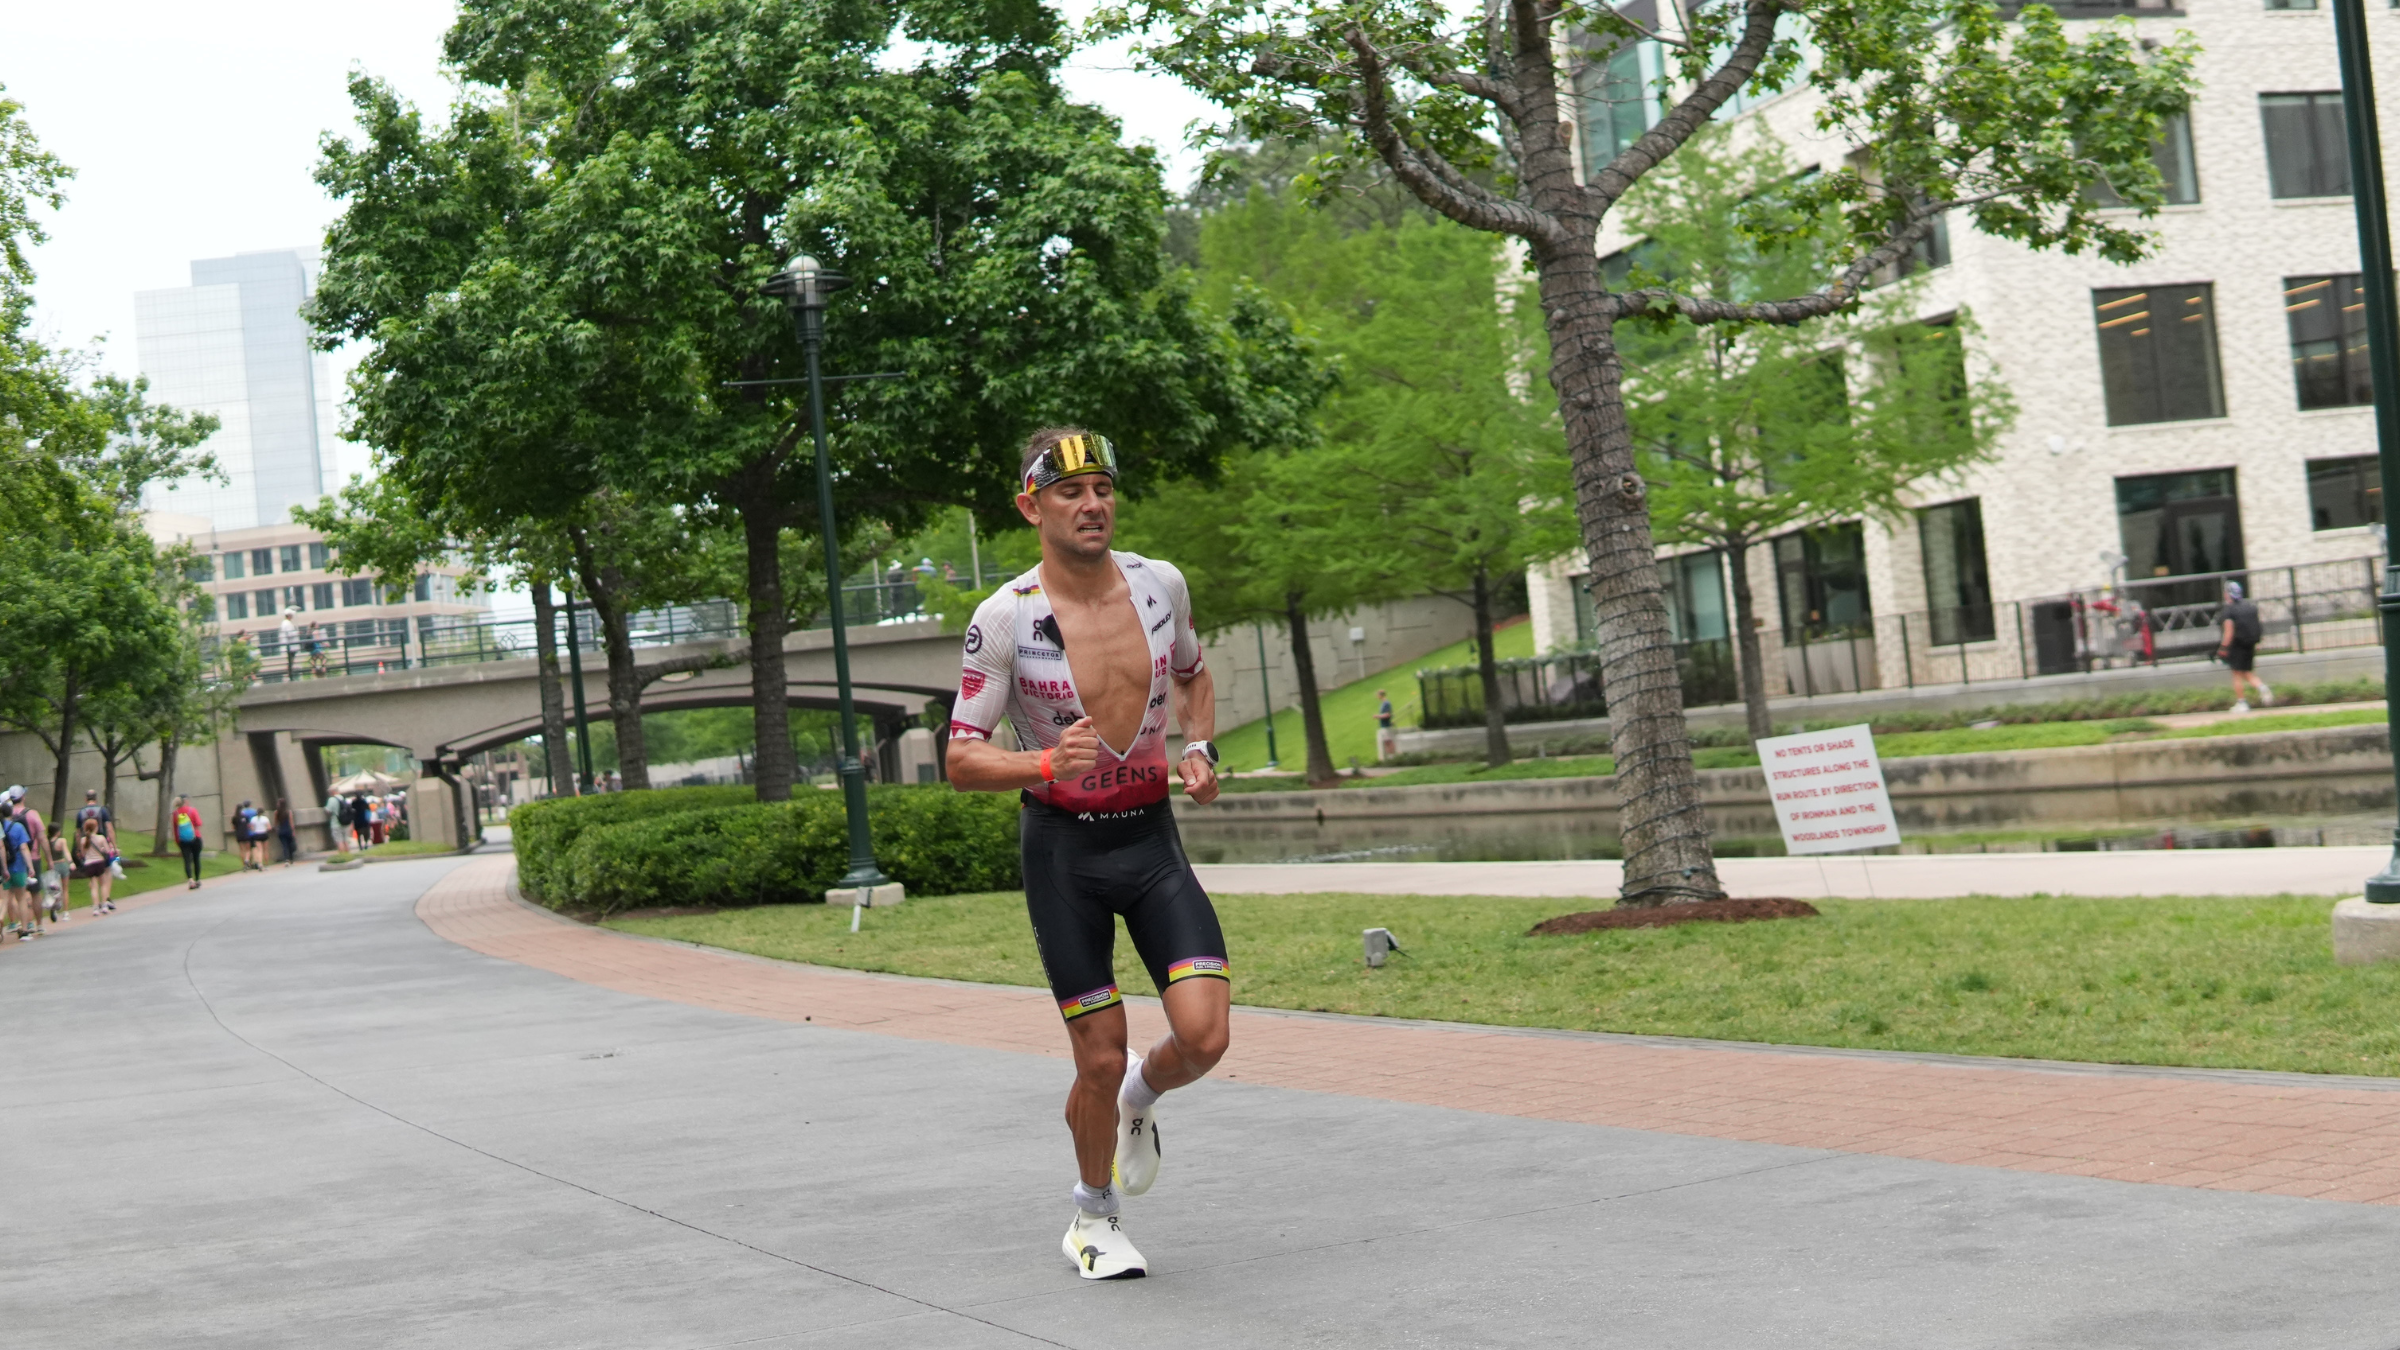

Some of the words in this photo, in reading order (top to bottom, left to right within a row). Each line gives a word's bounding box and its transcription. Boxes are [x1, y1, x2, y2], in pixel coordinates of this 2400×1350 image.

[1151, 611, 1172, 635] RIDLEY
[1019, 677, 1071, 692] BAHRA
[1022, 688, 1074, 700] VICTORIO
[1774, 749, 1787, 758] NO
[1787, 745, 1812, 757] TENTS
[1813, 743, 1825, 753] OR
[1826, 739, 1855, 751] SHADE
[1081, 766, 1158, 791] GEENS
[1772, 766, 1821, 780] STRUCTURES
[1823, 762, 1852, 774] ALONG
[1853, 759, 1870, 769] THE
[1776, 792, 1792, 801] RUN
[1821, 787, 1832, 796] BY
[1833, 781, 1879, 794] DIRECTION
[1790, 812, 1800, 821] OF
[1801, 808, 1837, 820] IRONMAN
[1840, 805, 1857, 815] AND
[1858, 803, 1876, 812] THE
[1791, 830, 1840, 842] WOODLANDS
[1841, 824, 1887, 837] TOWNSHIP
